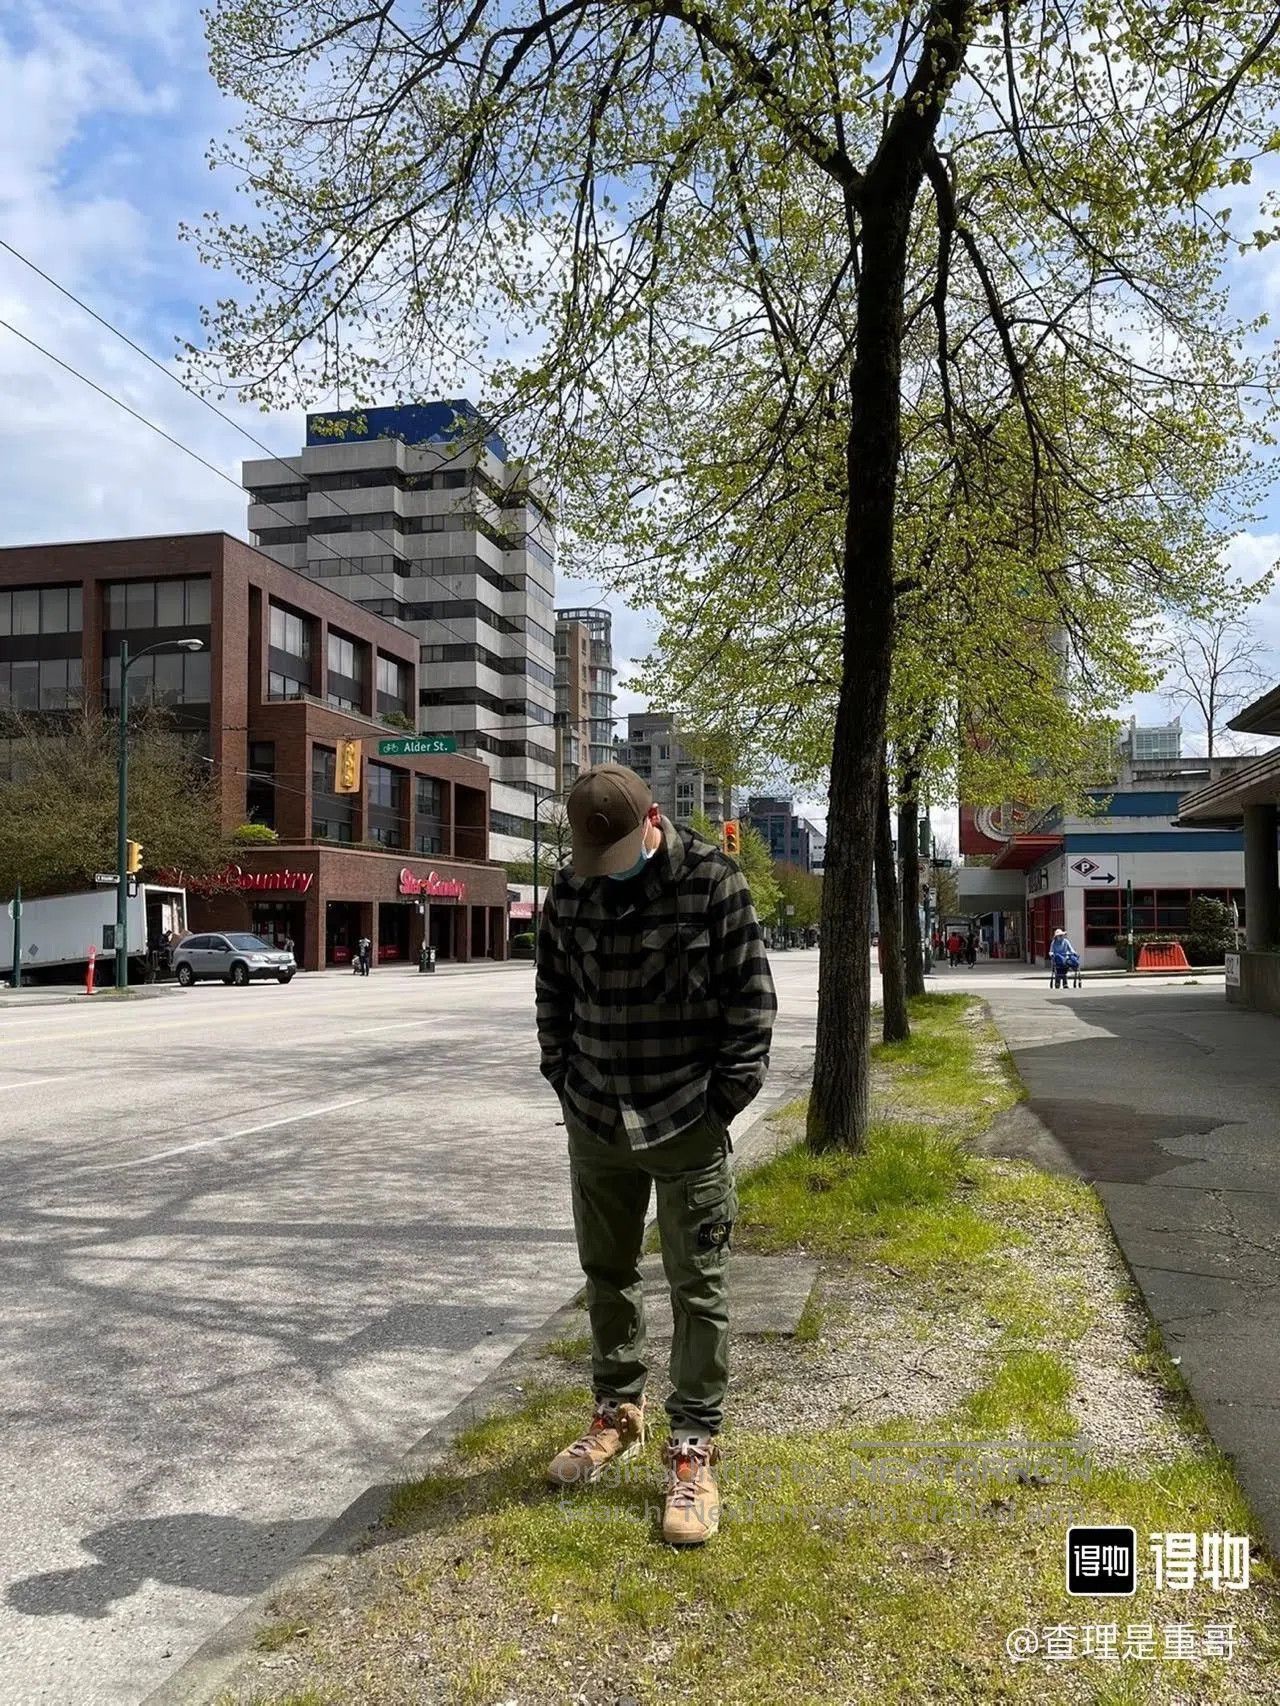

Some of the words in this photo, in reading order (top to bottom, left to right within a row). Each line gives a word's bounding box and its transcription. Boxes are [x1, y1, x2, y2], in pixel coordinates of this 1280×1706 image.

[403, 741, 431, 752] Alder
[433, 740, 448, 751] St.
[1081, 862, 1091, 873] P
